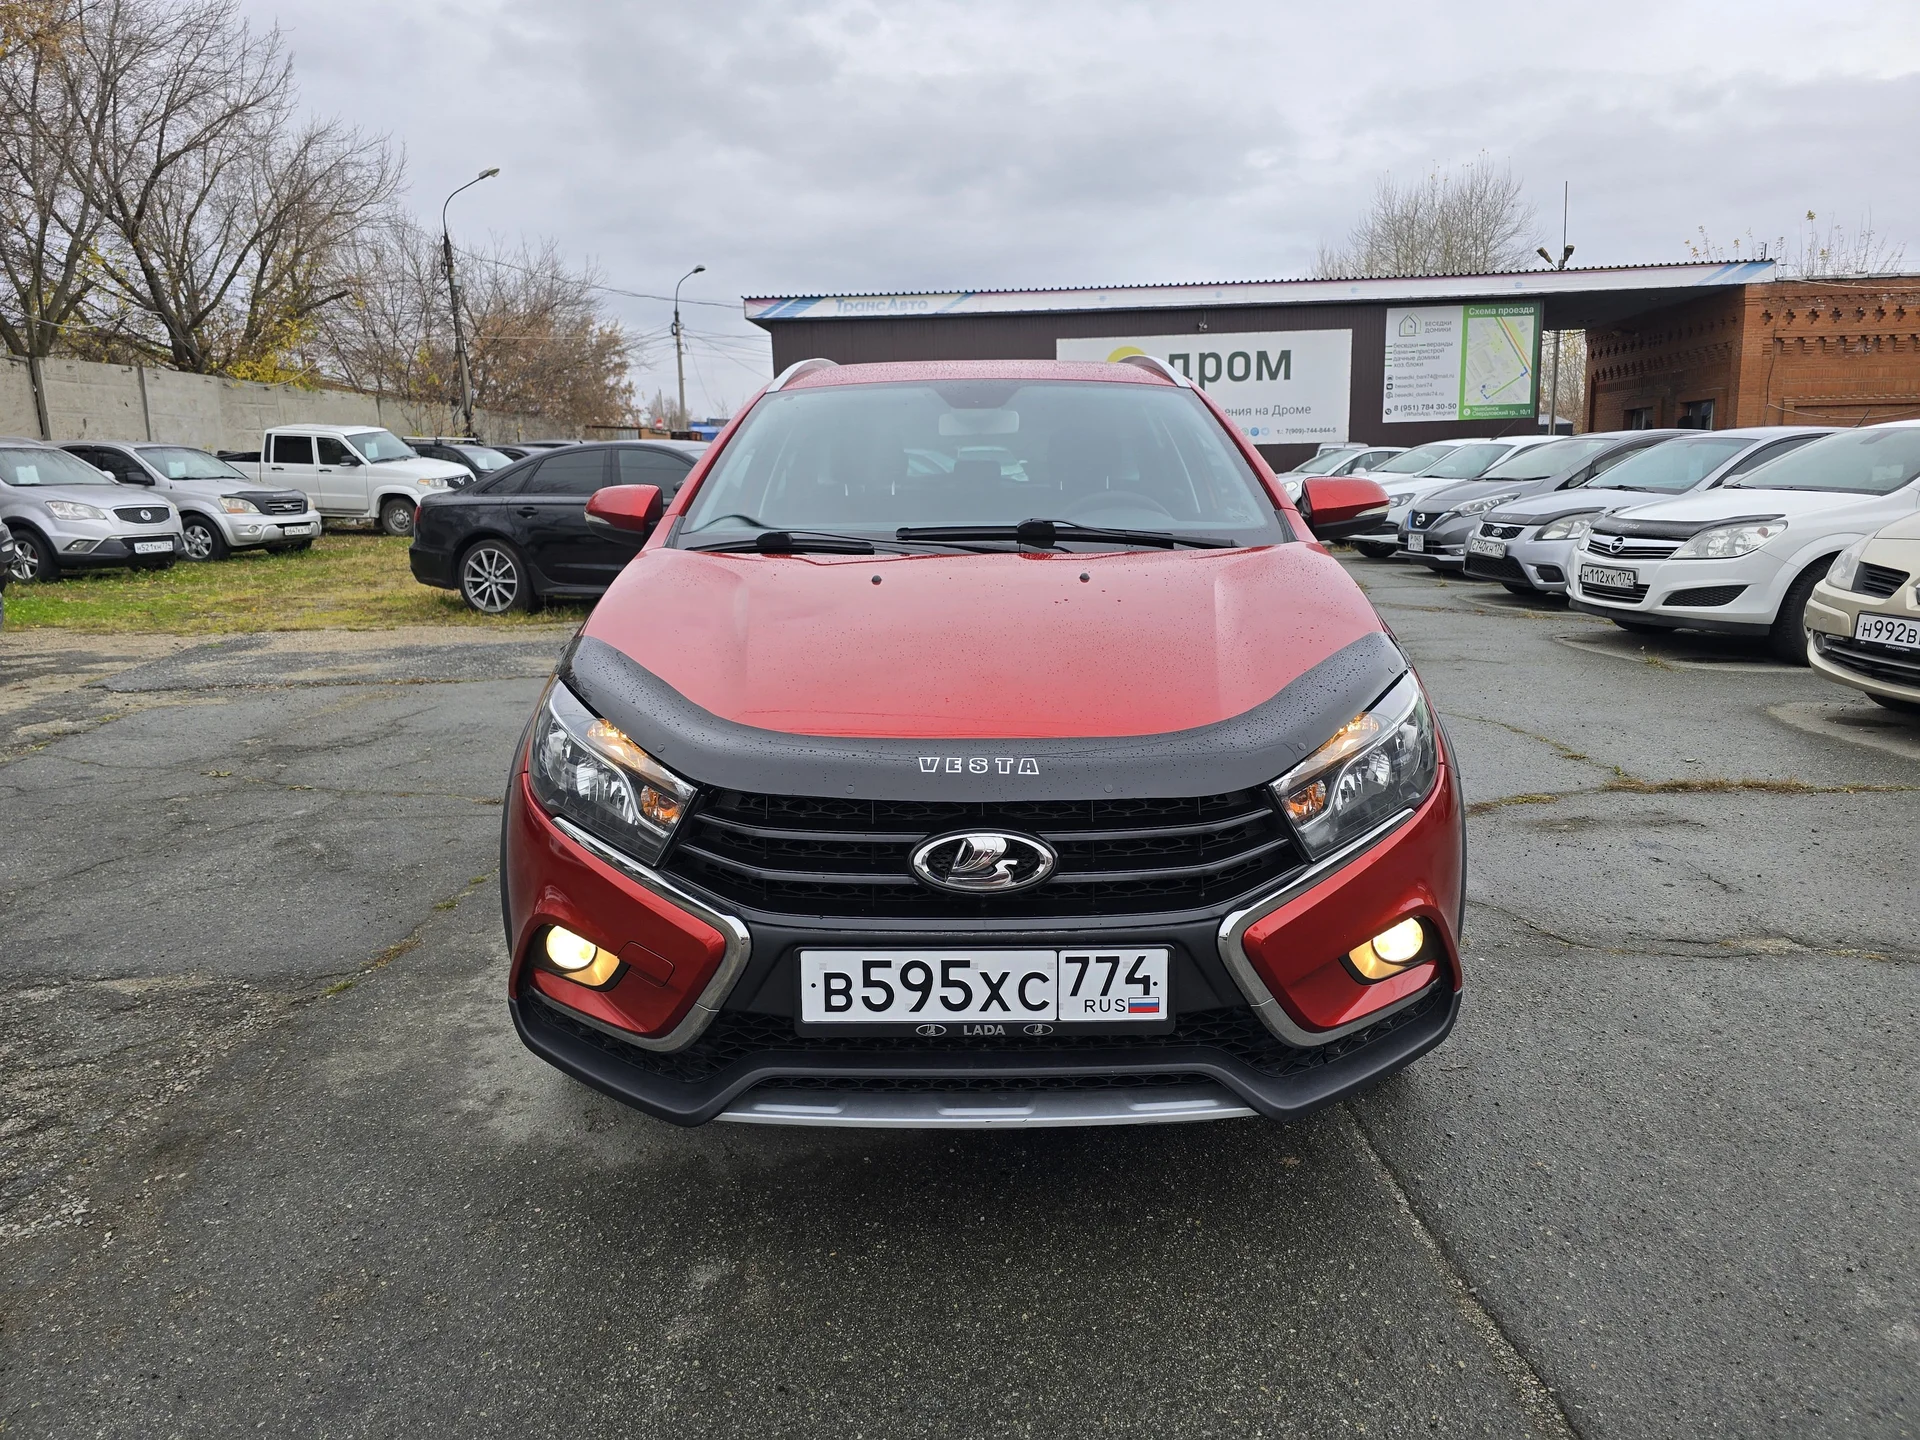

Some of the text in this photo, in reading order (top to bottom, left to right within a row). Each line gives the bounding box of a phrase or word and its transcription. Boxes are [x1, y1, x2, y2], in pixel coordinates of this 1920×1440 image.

[836, 297, 929, 313] ТрансАвто
[1468, 306, 1535, 316] Схема проезда
[1168, 349, 1292, 391] дром
[1225, 404, 1311, 418] ения на Дроме
[1400, 404, 1419, 412] (951)
[1435, 402, 1457, 410] 30-50
[1583, 568, 1632, 585] Н112ХК 174
[1861, 619, 1920, 645] Н992В
[919, 757, 1040, 775] VESTA
[823, 955, 1151, 1013] В595ХС 774
[1084, 998, 1126, 1013] RUS
[963, 1024, 1006, 1036] LADA
